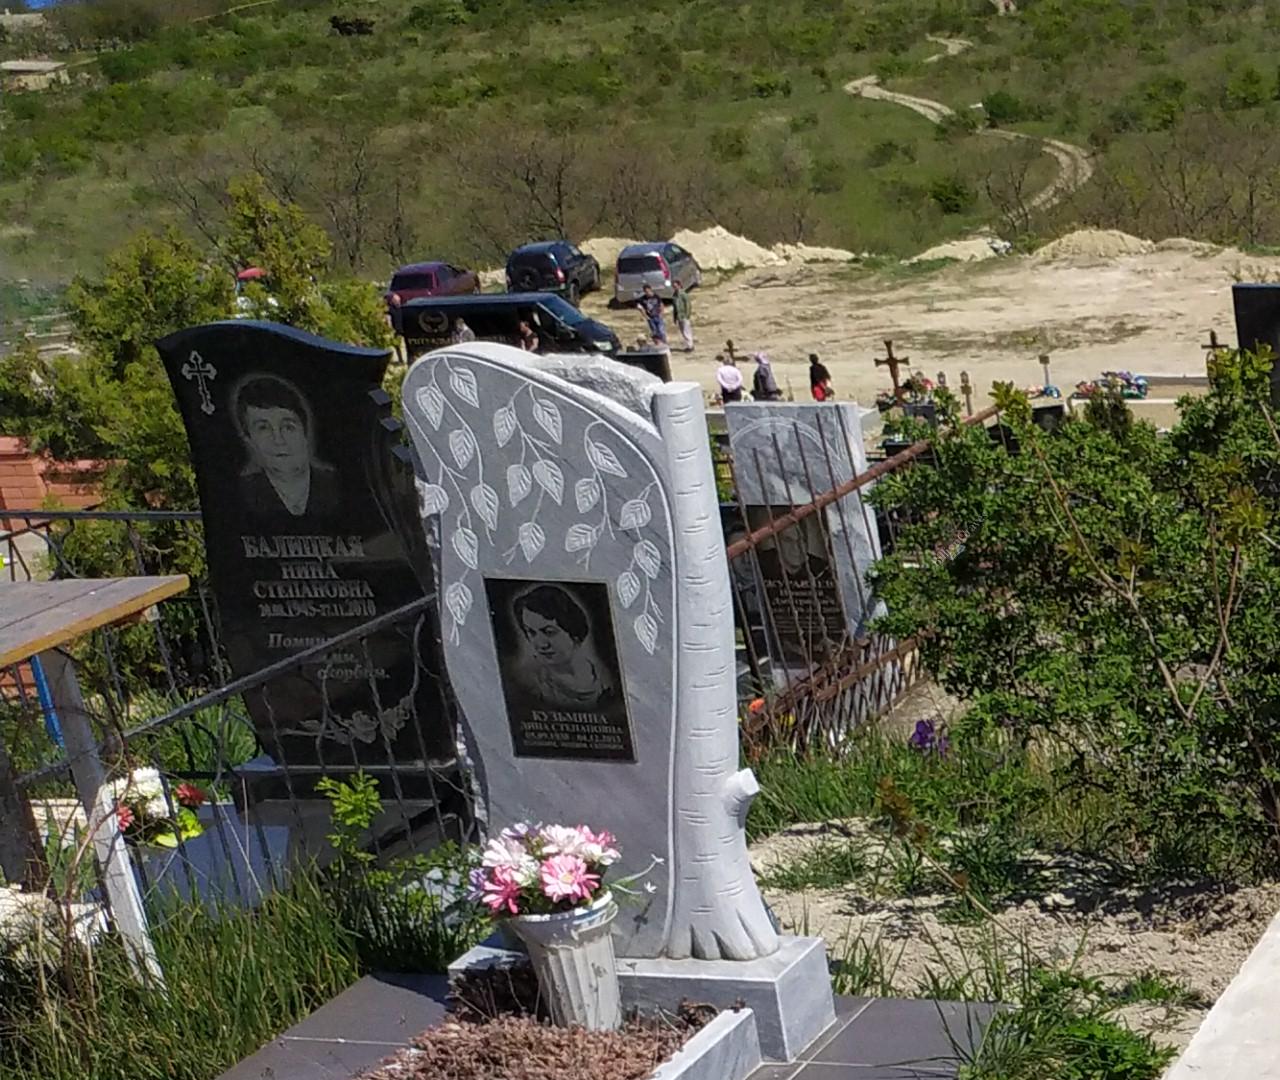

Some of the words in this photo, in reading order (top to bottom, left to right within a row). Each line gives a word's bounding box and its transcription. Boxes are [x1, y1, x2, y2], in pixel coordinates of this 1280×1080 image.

[241, 535, 365, 562] БАЛИЦКАЯ
[280, 561, 340, 579] НИНА
[253, 580, 375, 599] СТЕПАНОВНА
